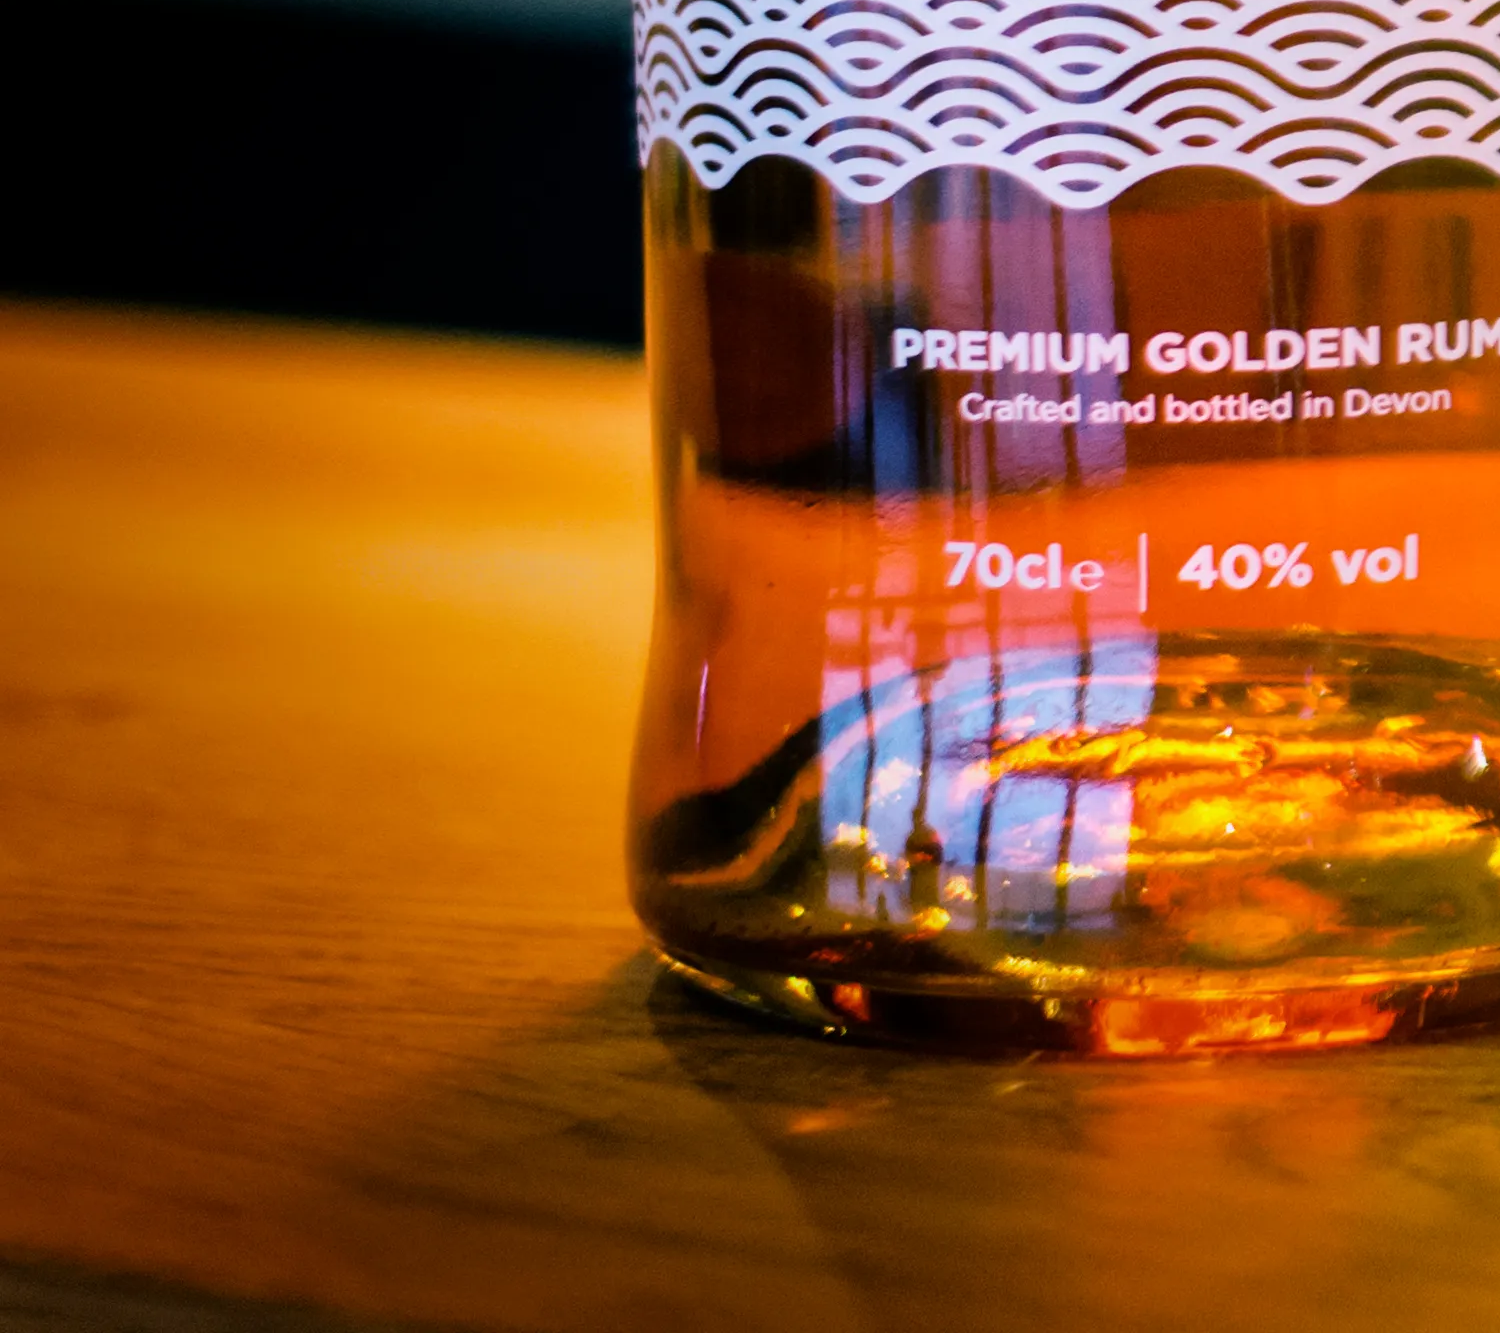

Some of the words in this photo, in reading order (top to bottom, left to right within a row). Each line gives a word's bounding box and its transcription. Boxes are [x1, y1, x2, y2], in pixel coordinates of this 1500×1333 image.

[892, 328, 1130, 375] PREMIUM
[1145, 326, 1381, 375] GOLDEN
[959, 391, 1081, 424] Crafted
[1088, 391, 1157, 425] and
[1165, 389, 1293, 423] bottled
[1302, 391, 1335, 420] in
[1343, 385, 1451, 417] Devon
[1178, 541, 1314, 591] 40%
[1331, 534, 1419, 586] vol
